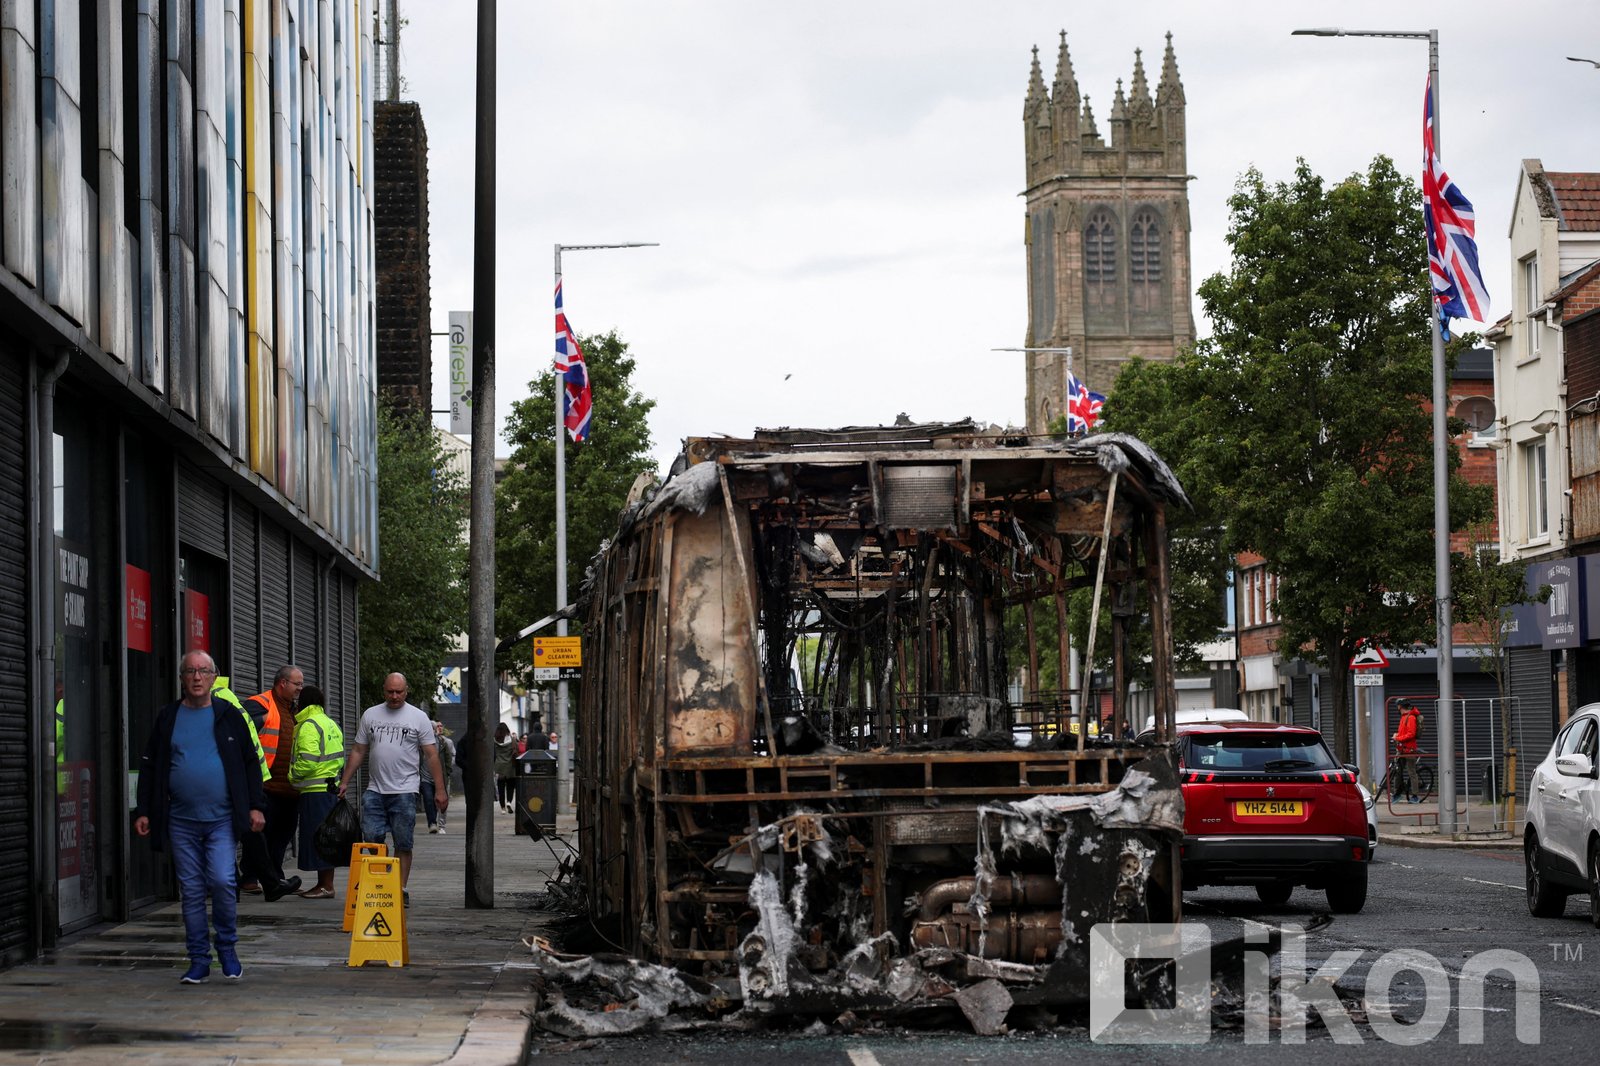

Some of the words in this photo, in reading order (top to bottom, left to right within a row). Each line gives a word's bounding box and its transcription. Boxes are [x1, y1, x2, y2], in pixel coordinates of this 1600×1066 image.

[451, 324, 469, 395] refresh
[452, 401, 461, 421] café
[1244, 803, 1267, 814] YHZ
[1270, 803, 1296, 814] 5144
[59, 820, 77, 850] CHOICE
